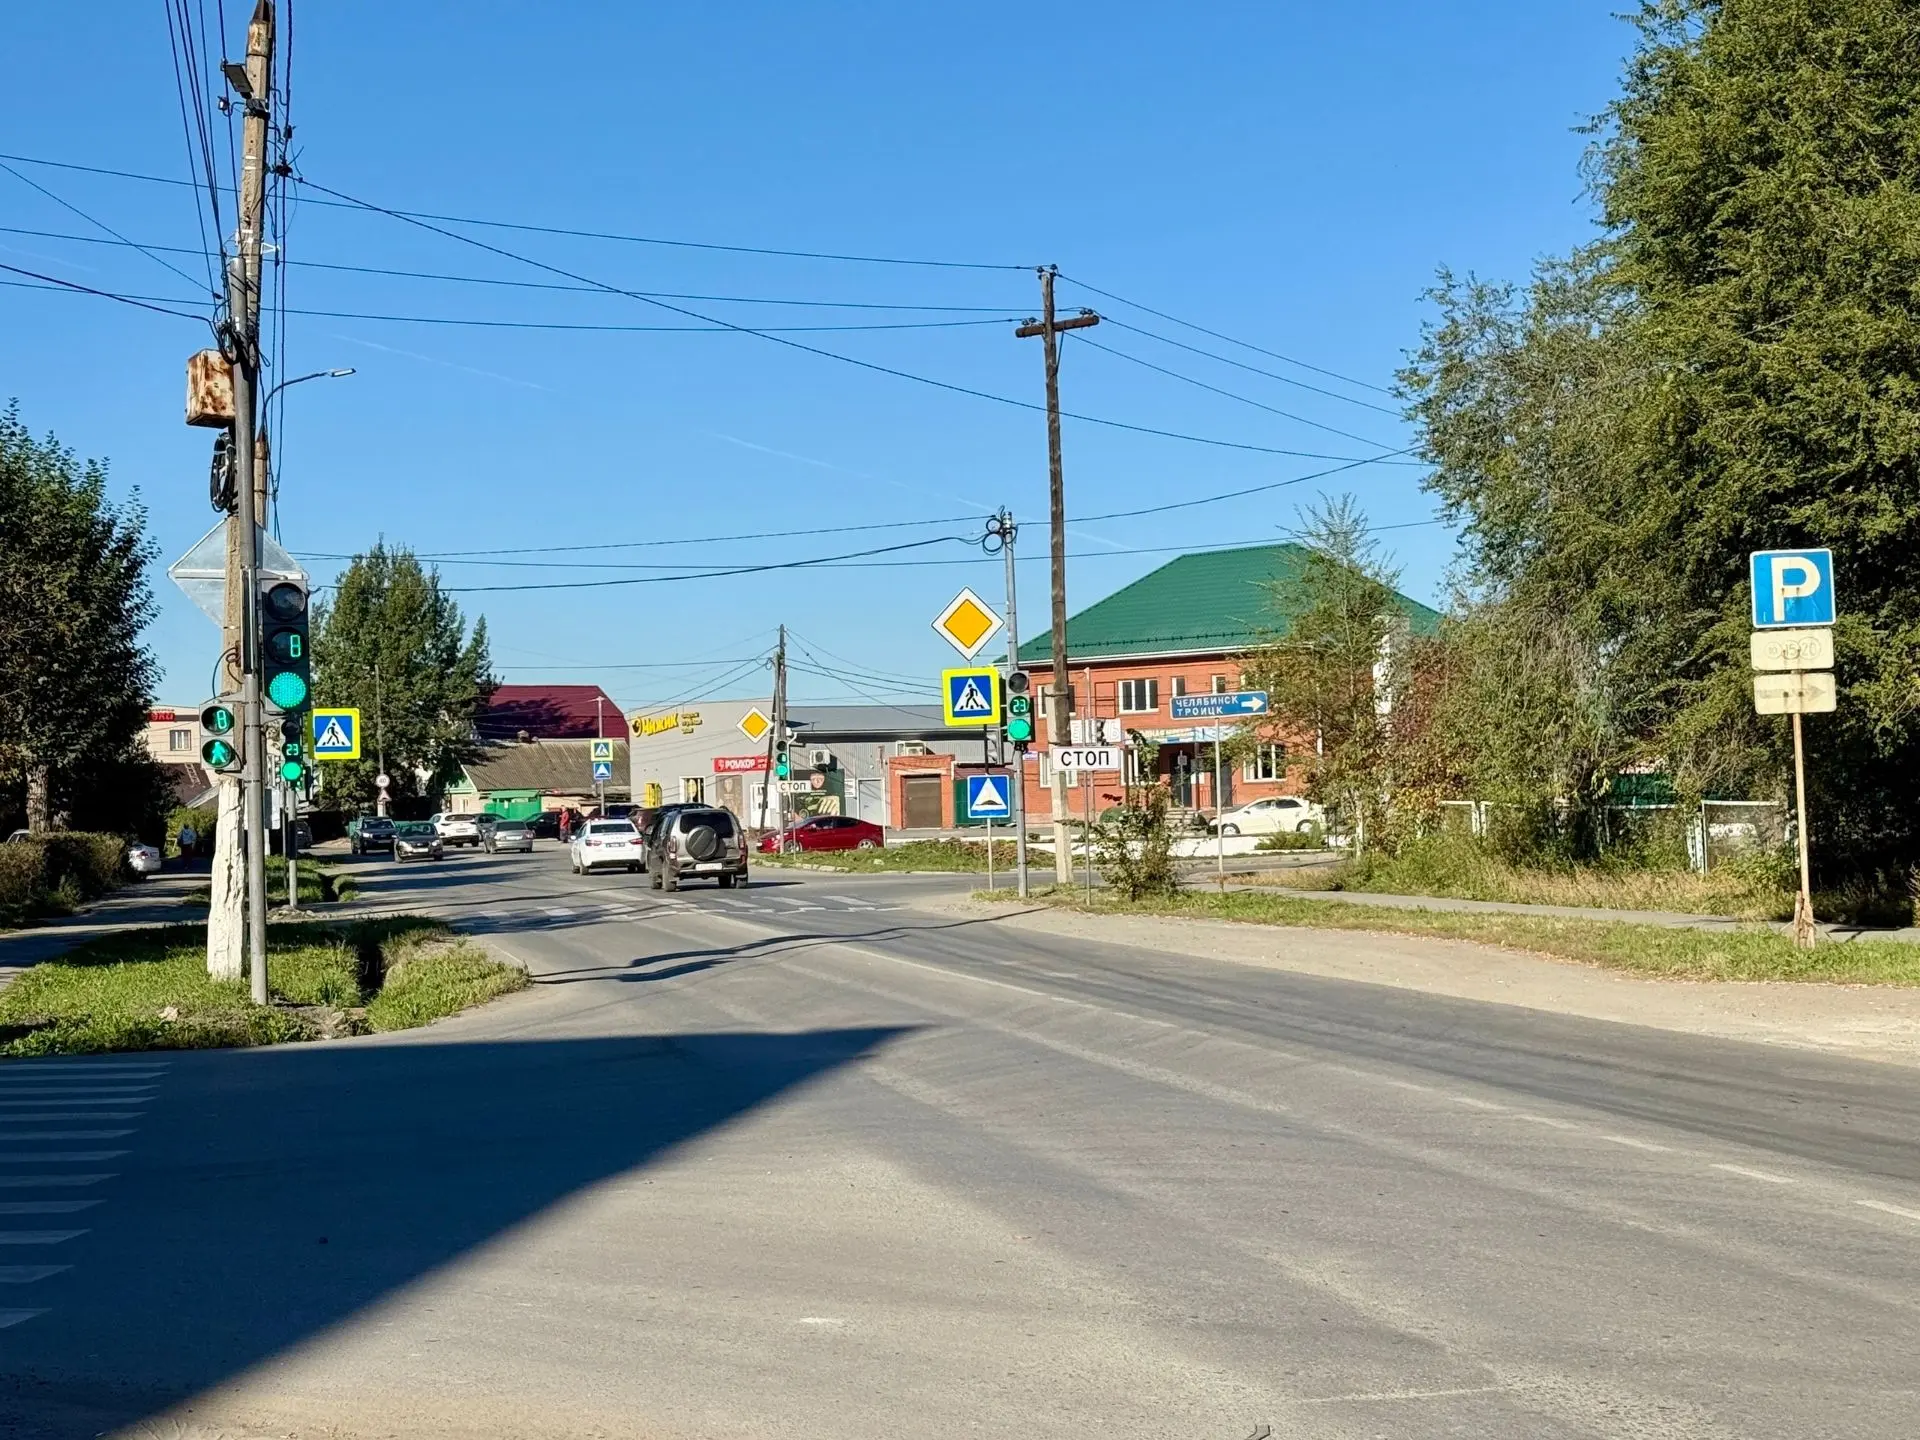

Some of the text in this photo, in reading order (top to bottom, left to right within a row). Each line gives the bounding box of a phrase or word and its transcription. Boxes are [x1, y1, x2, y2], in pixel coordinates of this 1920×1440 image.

[1771, 557, 1821, 622] P
[290, 634, 301, 657] 8
[1785, 643, 1797, 656] 15
[1012, 699, 1027, 713] 23
[1175, 695, 1239, 707] ЧЕЛЯБИНСК
[1176, 706, 1224, 716] ТРОИЦК
[217, 709, 227, 730] 8
[286, 743, 299, 756] 23
[1061, 750, 1109, 767] СТОП
[780, 782, 806, 791] СТОП
